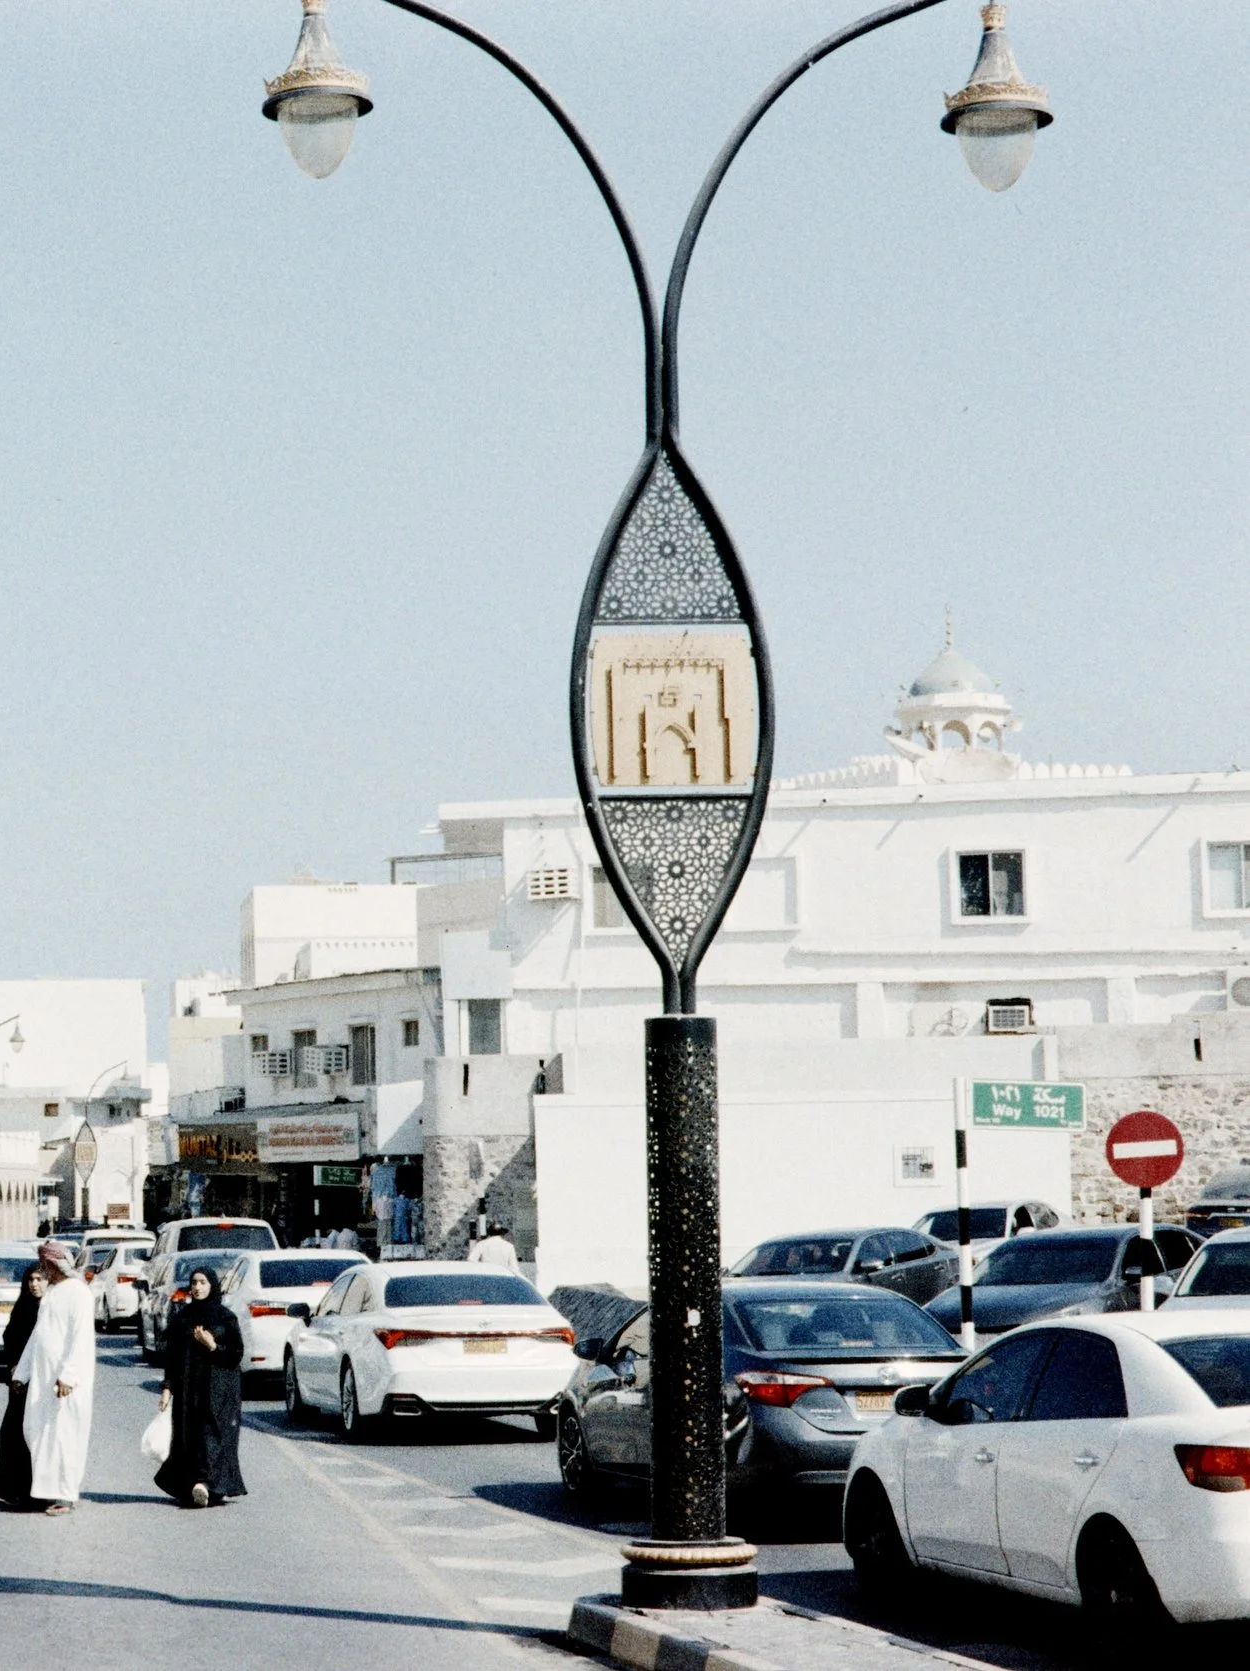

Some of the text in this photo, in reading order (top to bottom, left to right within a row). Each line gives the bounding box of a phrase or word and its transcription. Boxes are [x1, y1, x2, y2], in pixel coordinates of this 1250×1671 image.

[991, 1084, 1066, 1104] سكة ١٠٢١
[992, 1103, 1022, 1121] Way
[1033, 1104, 1065, 1119] 1021
